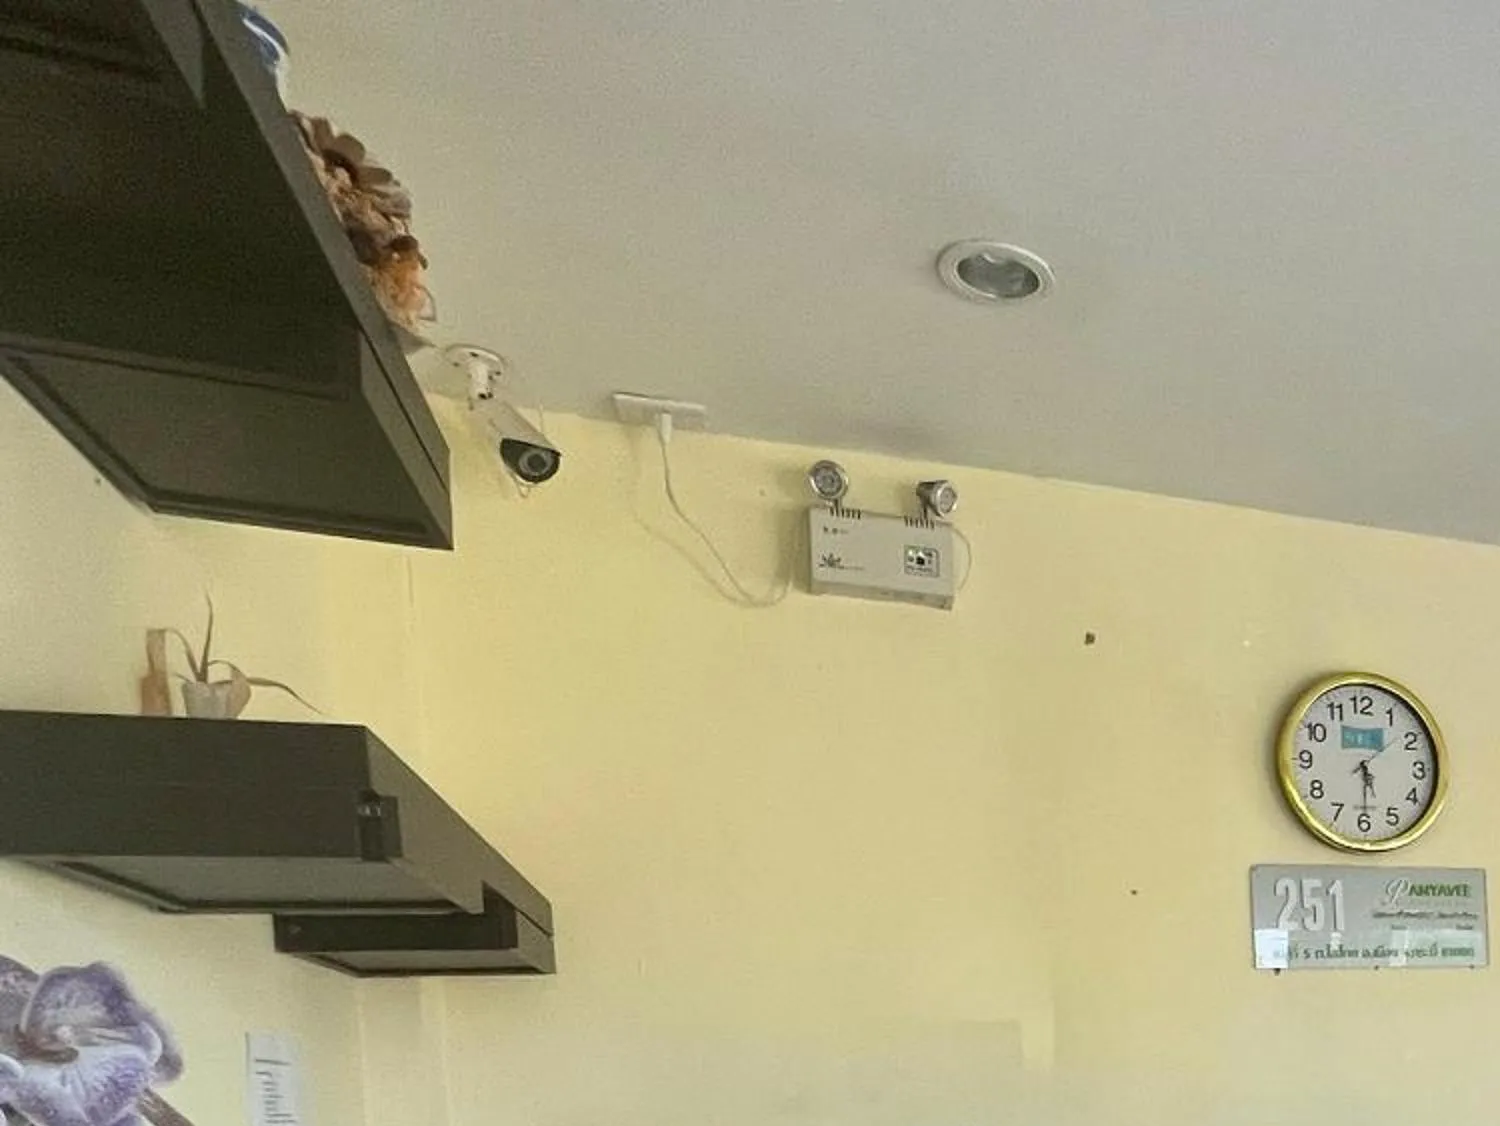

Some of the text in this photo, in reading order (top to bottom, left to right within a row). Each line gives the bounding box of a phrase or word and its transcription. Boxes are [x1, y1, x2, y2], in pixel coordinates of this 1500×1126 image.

[1327, 702, 1344, 721] 11
[1350, 696, 1374, 716] 12
[1385, 708, 1394, 727] 1
[1306, 723, 1327, 743] 10
[1403, 732, 1418, 751] 2
[1299, 750, 1313, 770] 9
[1412, 762, 1426, 781] 3
[1309, 779, 1324, 799] 8
[1405, 787, 1419, 805] 4
[1331, 802, 1345, 822] 7
[1386, 806, 1400, 826] 5
[1357, 813, 1371, 832] 6
[1274, 878, 1346, 931] 251
